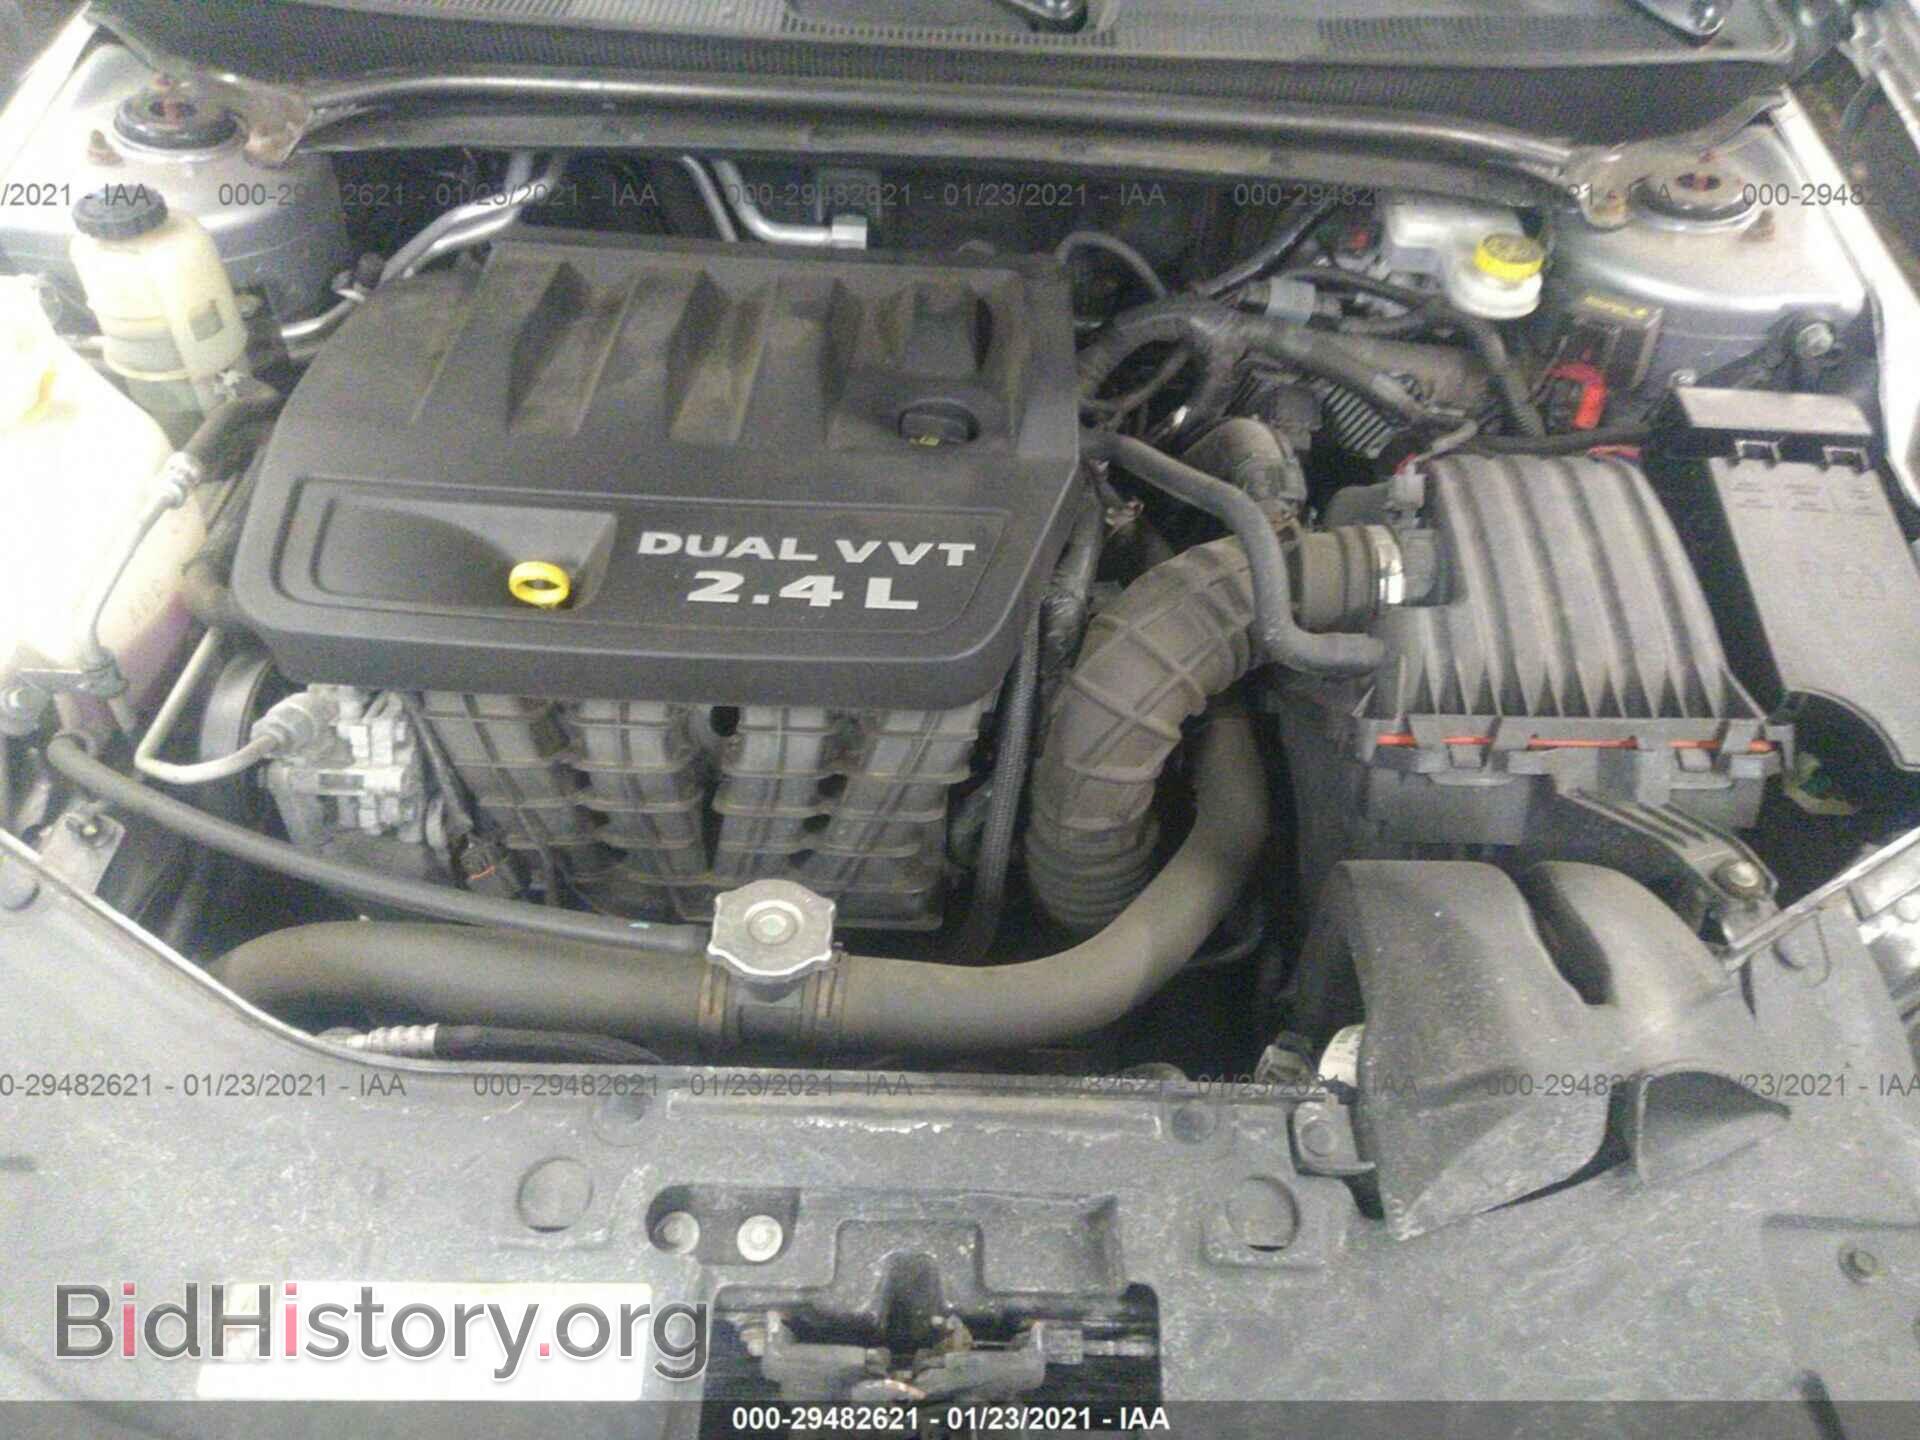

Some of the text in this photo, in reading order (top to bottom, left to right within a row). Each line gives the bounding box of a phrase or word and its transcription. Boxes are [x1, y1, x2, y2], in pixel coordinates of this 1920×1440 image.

[638, 532, 976, 567] DUAL VVT
[687, 570, 919, 611] 2.4 L
